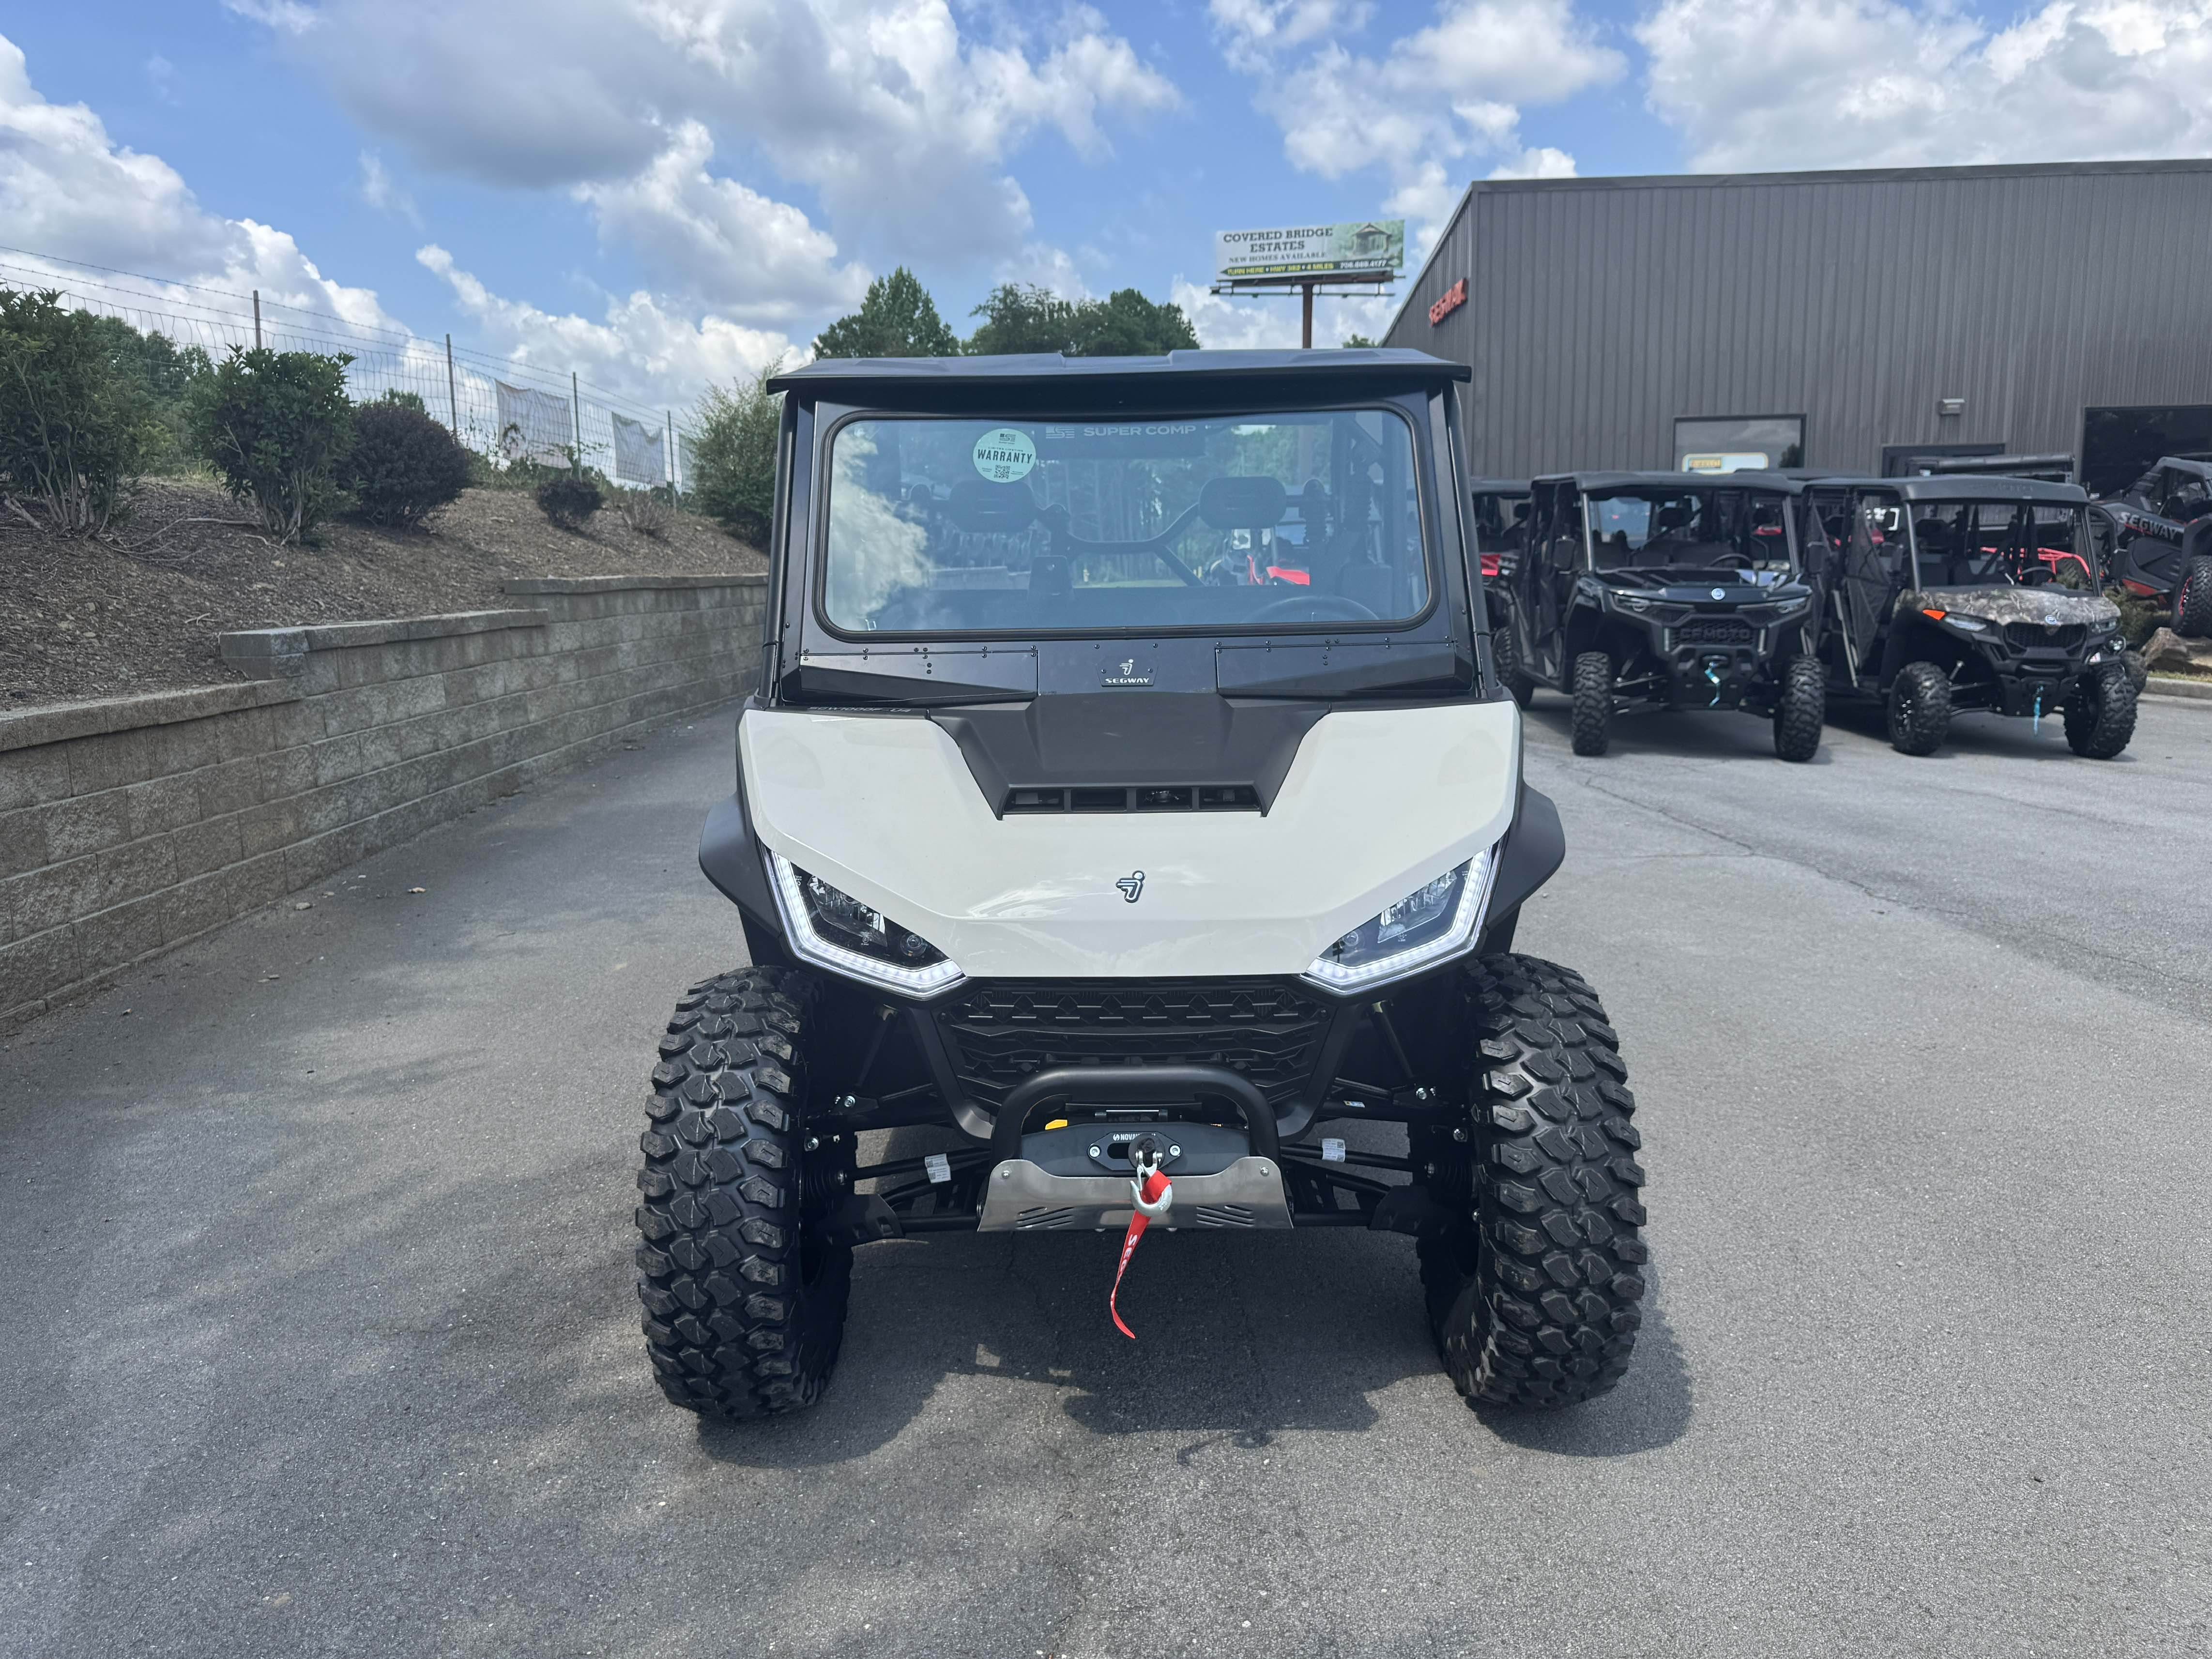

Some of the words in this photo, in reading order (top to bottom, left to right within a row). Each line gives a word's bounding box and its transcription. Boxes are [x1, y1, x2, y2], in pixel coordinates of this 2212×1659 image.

[1223, 231, 1282, 243] COVERED
[1286, 228, 1333, 239] BRIDGE
[1251, 241, 1305, 253] ESTATES
[1281, 252, 1326, 260] AVAILABLE
[1083, 426, 1141, 436] SUPER
[1145, 425, 1196, 435] COMP
[978, 449, 1032, 464] WARRANTY
[2119, 512, 2178, 540] SEGWAY
